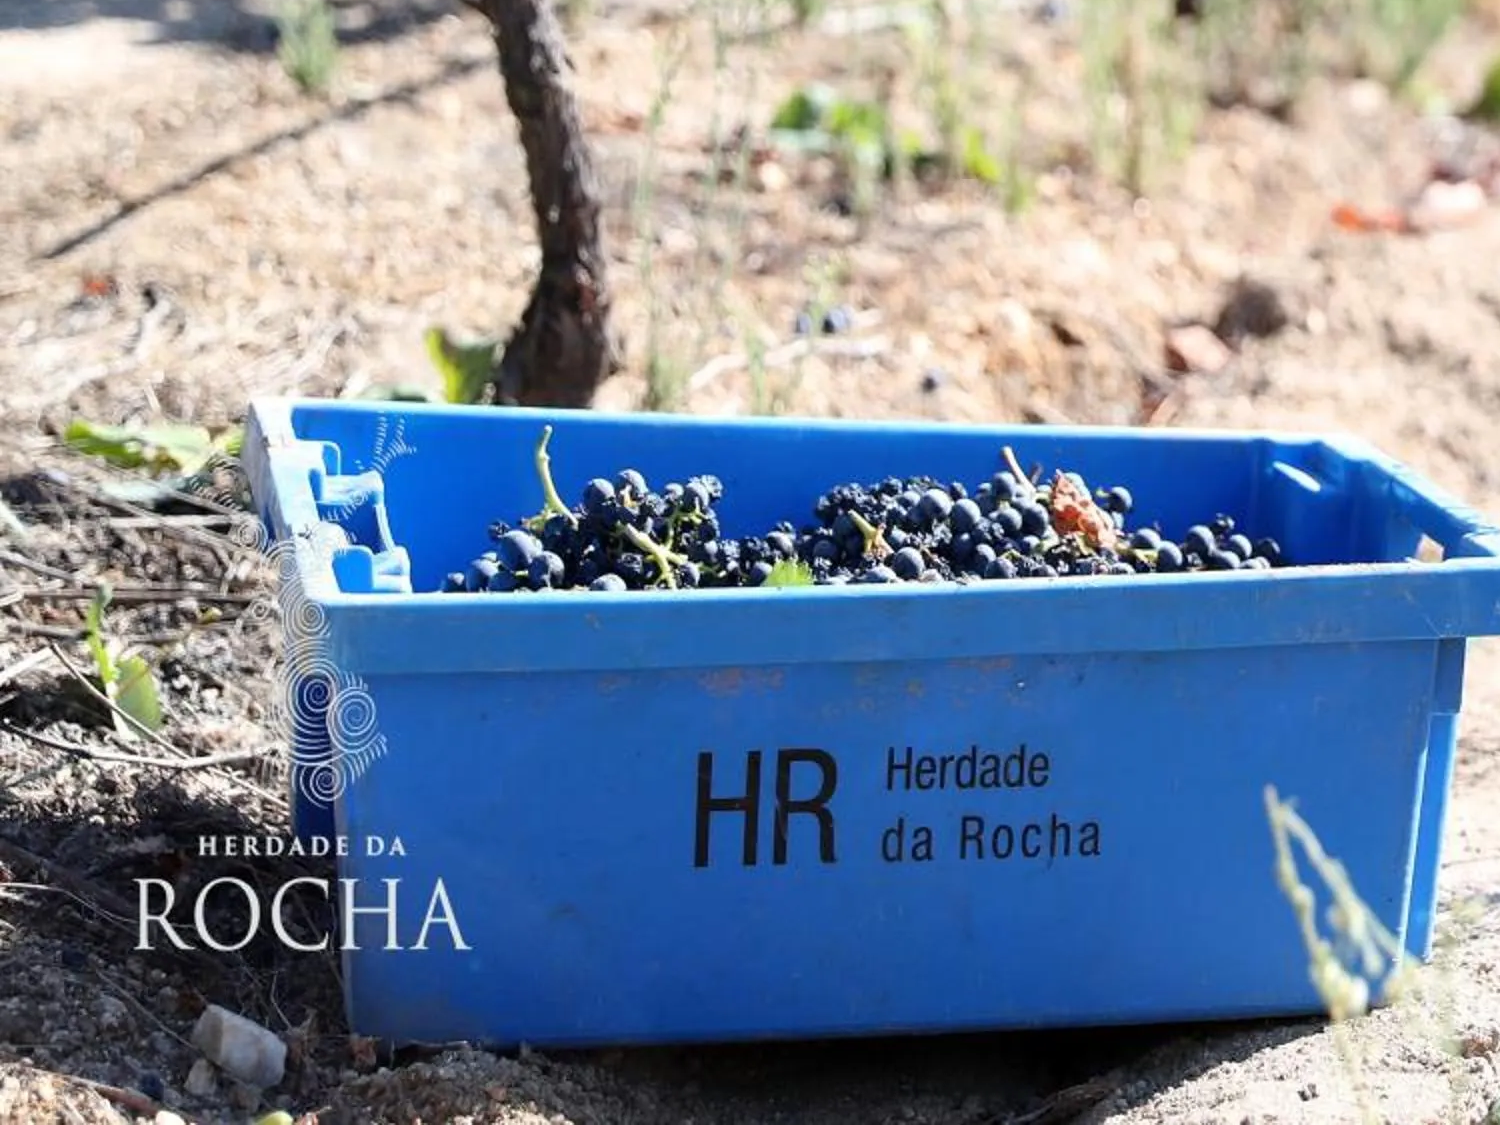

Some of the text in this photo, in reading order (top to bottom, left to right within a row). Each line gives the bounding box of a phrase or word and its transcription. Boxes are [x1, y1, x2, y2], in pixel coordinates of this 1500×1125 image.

[886, 744, 1051, 791] Herdade
[693, 747, 839, 869] HR
[881, 813, 1101, 863] da Rocha
